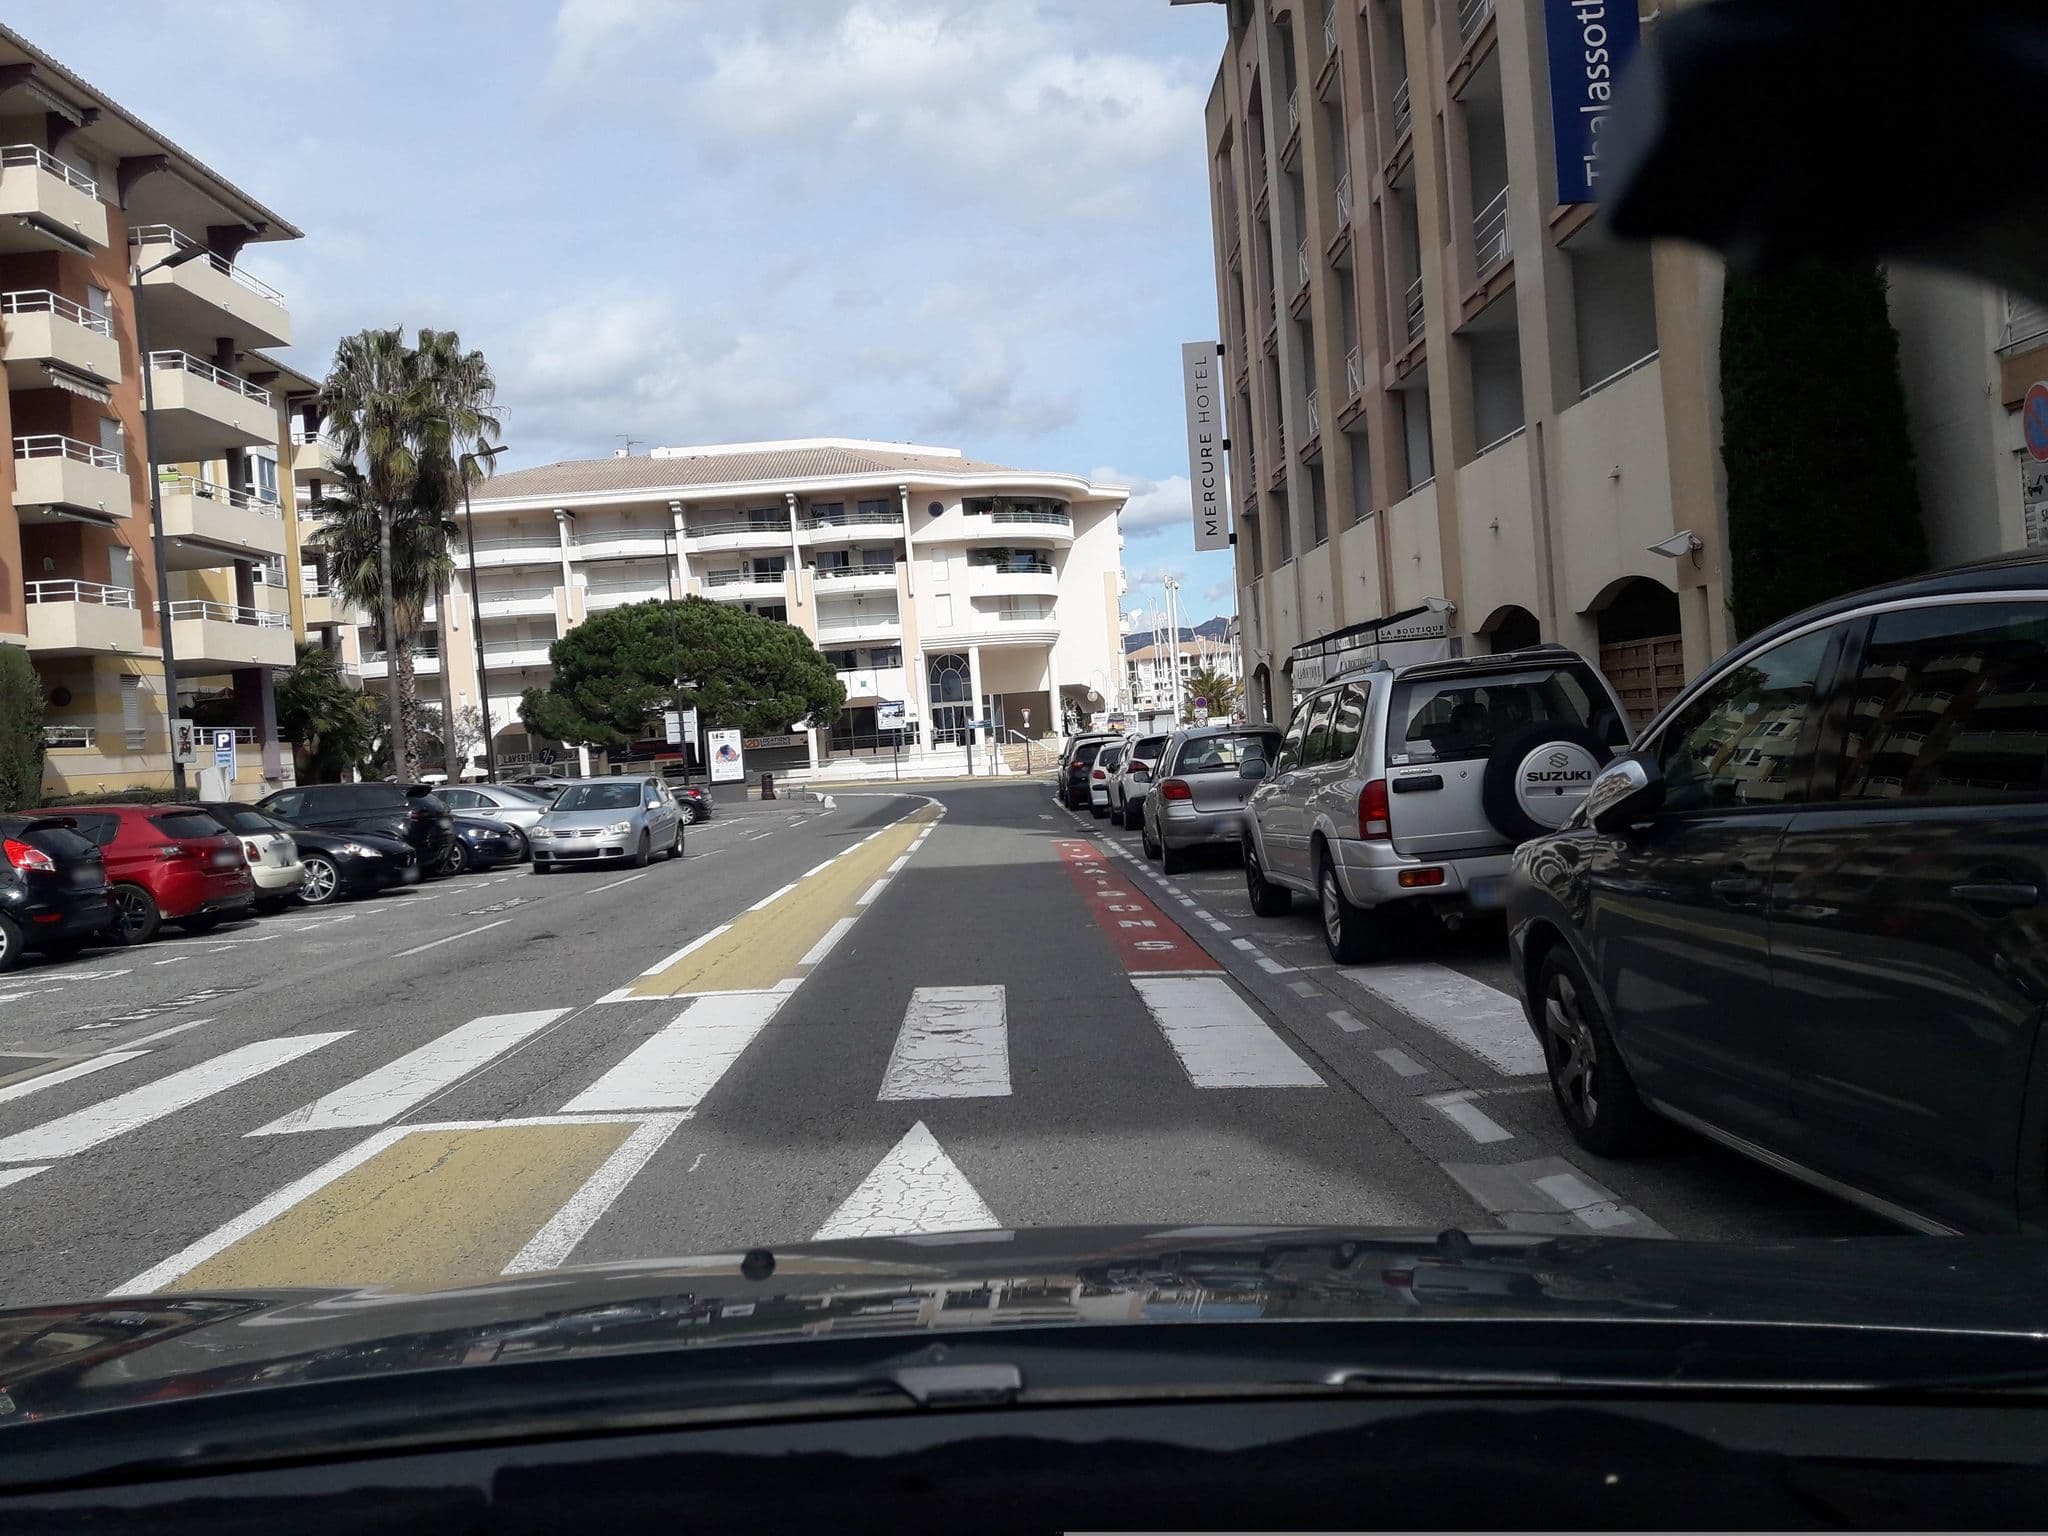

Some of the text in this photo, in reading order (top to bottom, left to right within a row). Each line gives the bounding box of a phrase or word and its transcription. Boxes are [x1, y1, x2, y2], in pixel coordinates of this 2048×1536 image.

[1194, 355, 1218, 537] MERCURE HOTEL
[1397, 625, 1444, 635] BOUTIQUE
[503, 752, 534, 764] LAVERIE
[1526, 770, 1592, 782] SUZUKI
